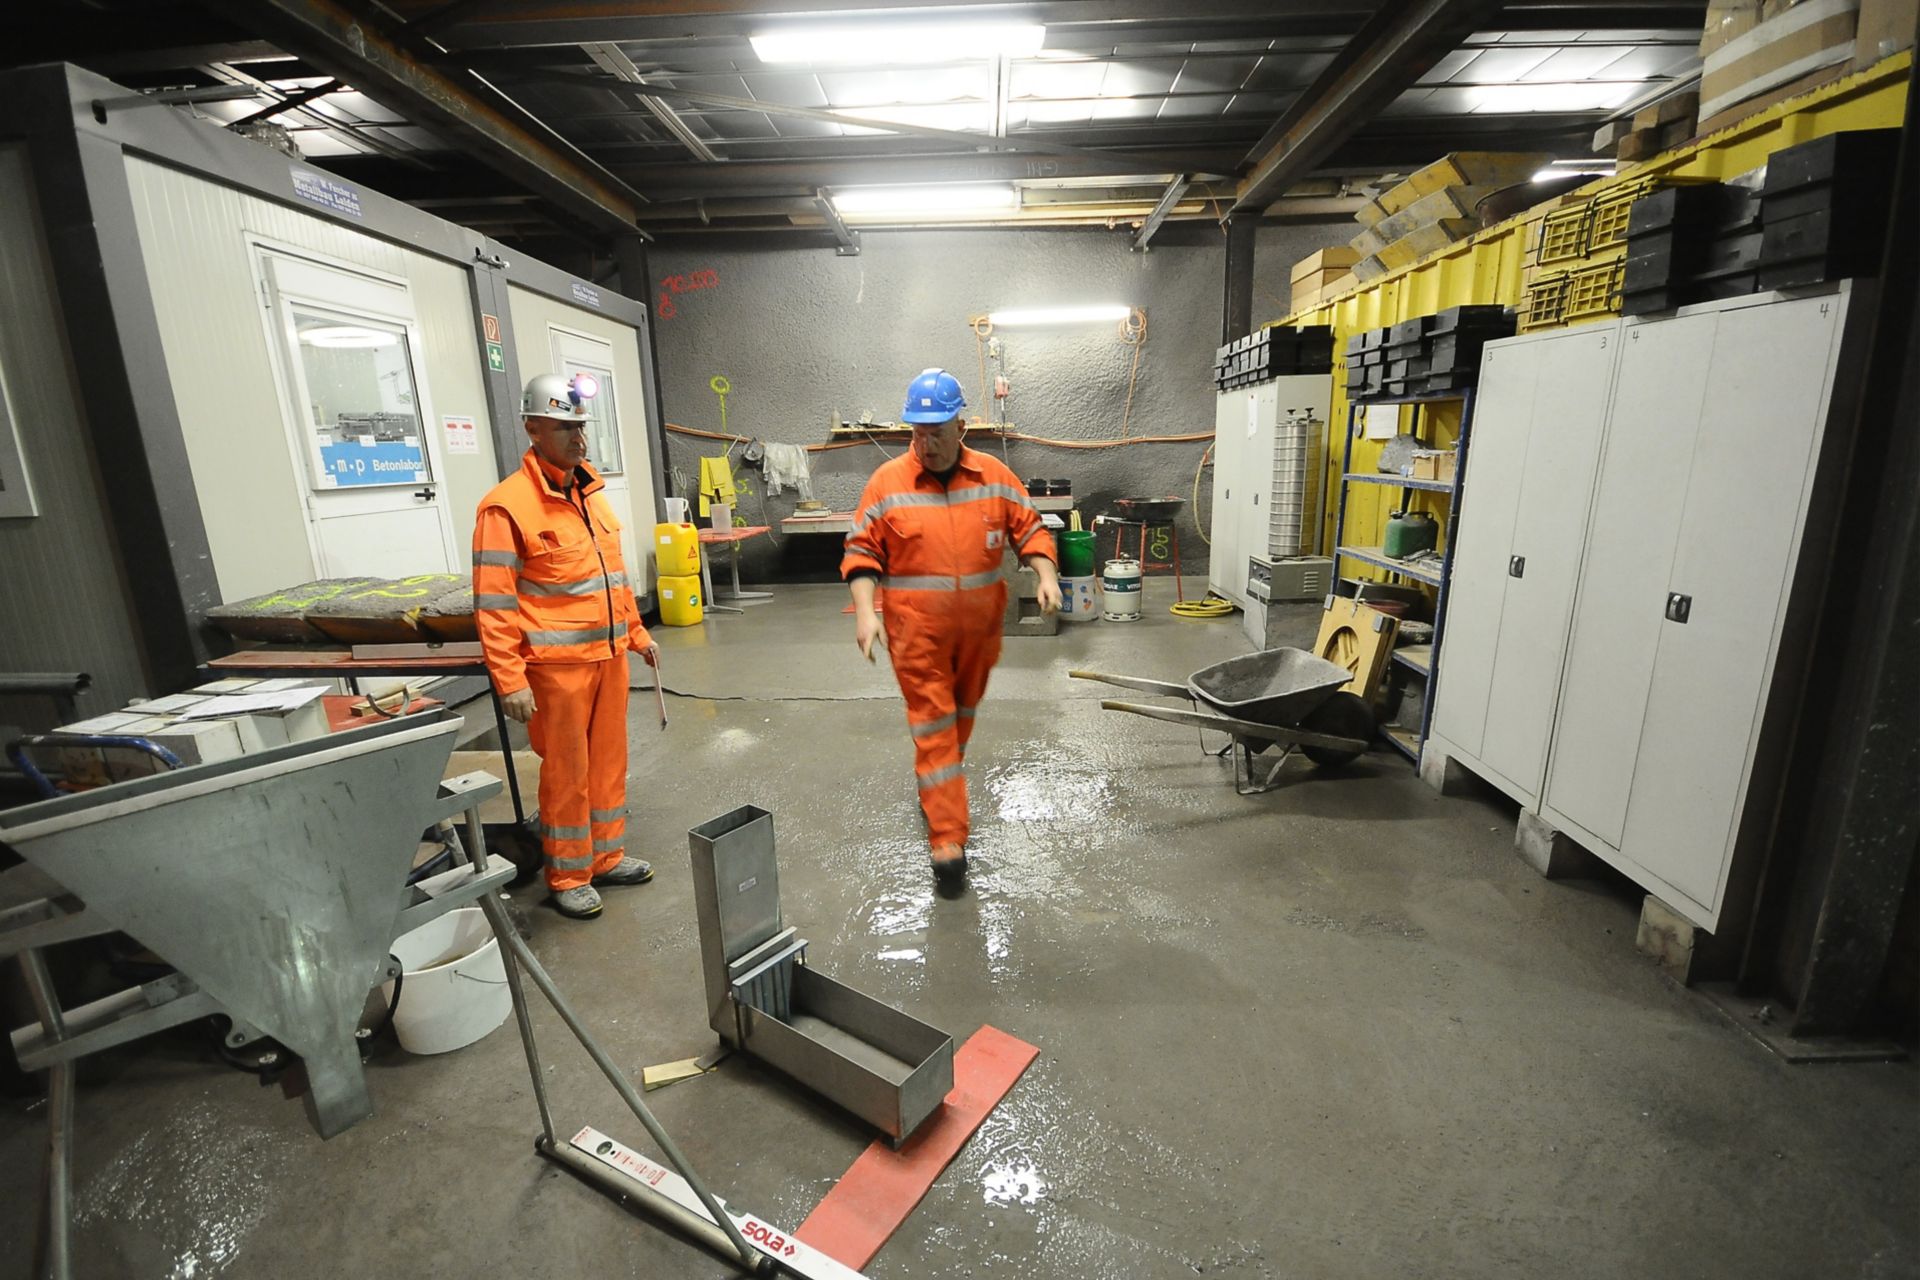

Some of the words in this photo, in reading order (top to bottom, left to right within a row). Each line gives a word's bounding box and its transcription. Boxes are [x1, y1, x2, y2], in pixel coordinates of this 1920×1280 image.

[1820, 303, 1829, 319] 4
[1600, 336, 1607, 350] 3
[1632, 330, 1640, 344] 4
[1488, 351, 1493, 362] 3
